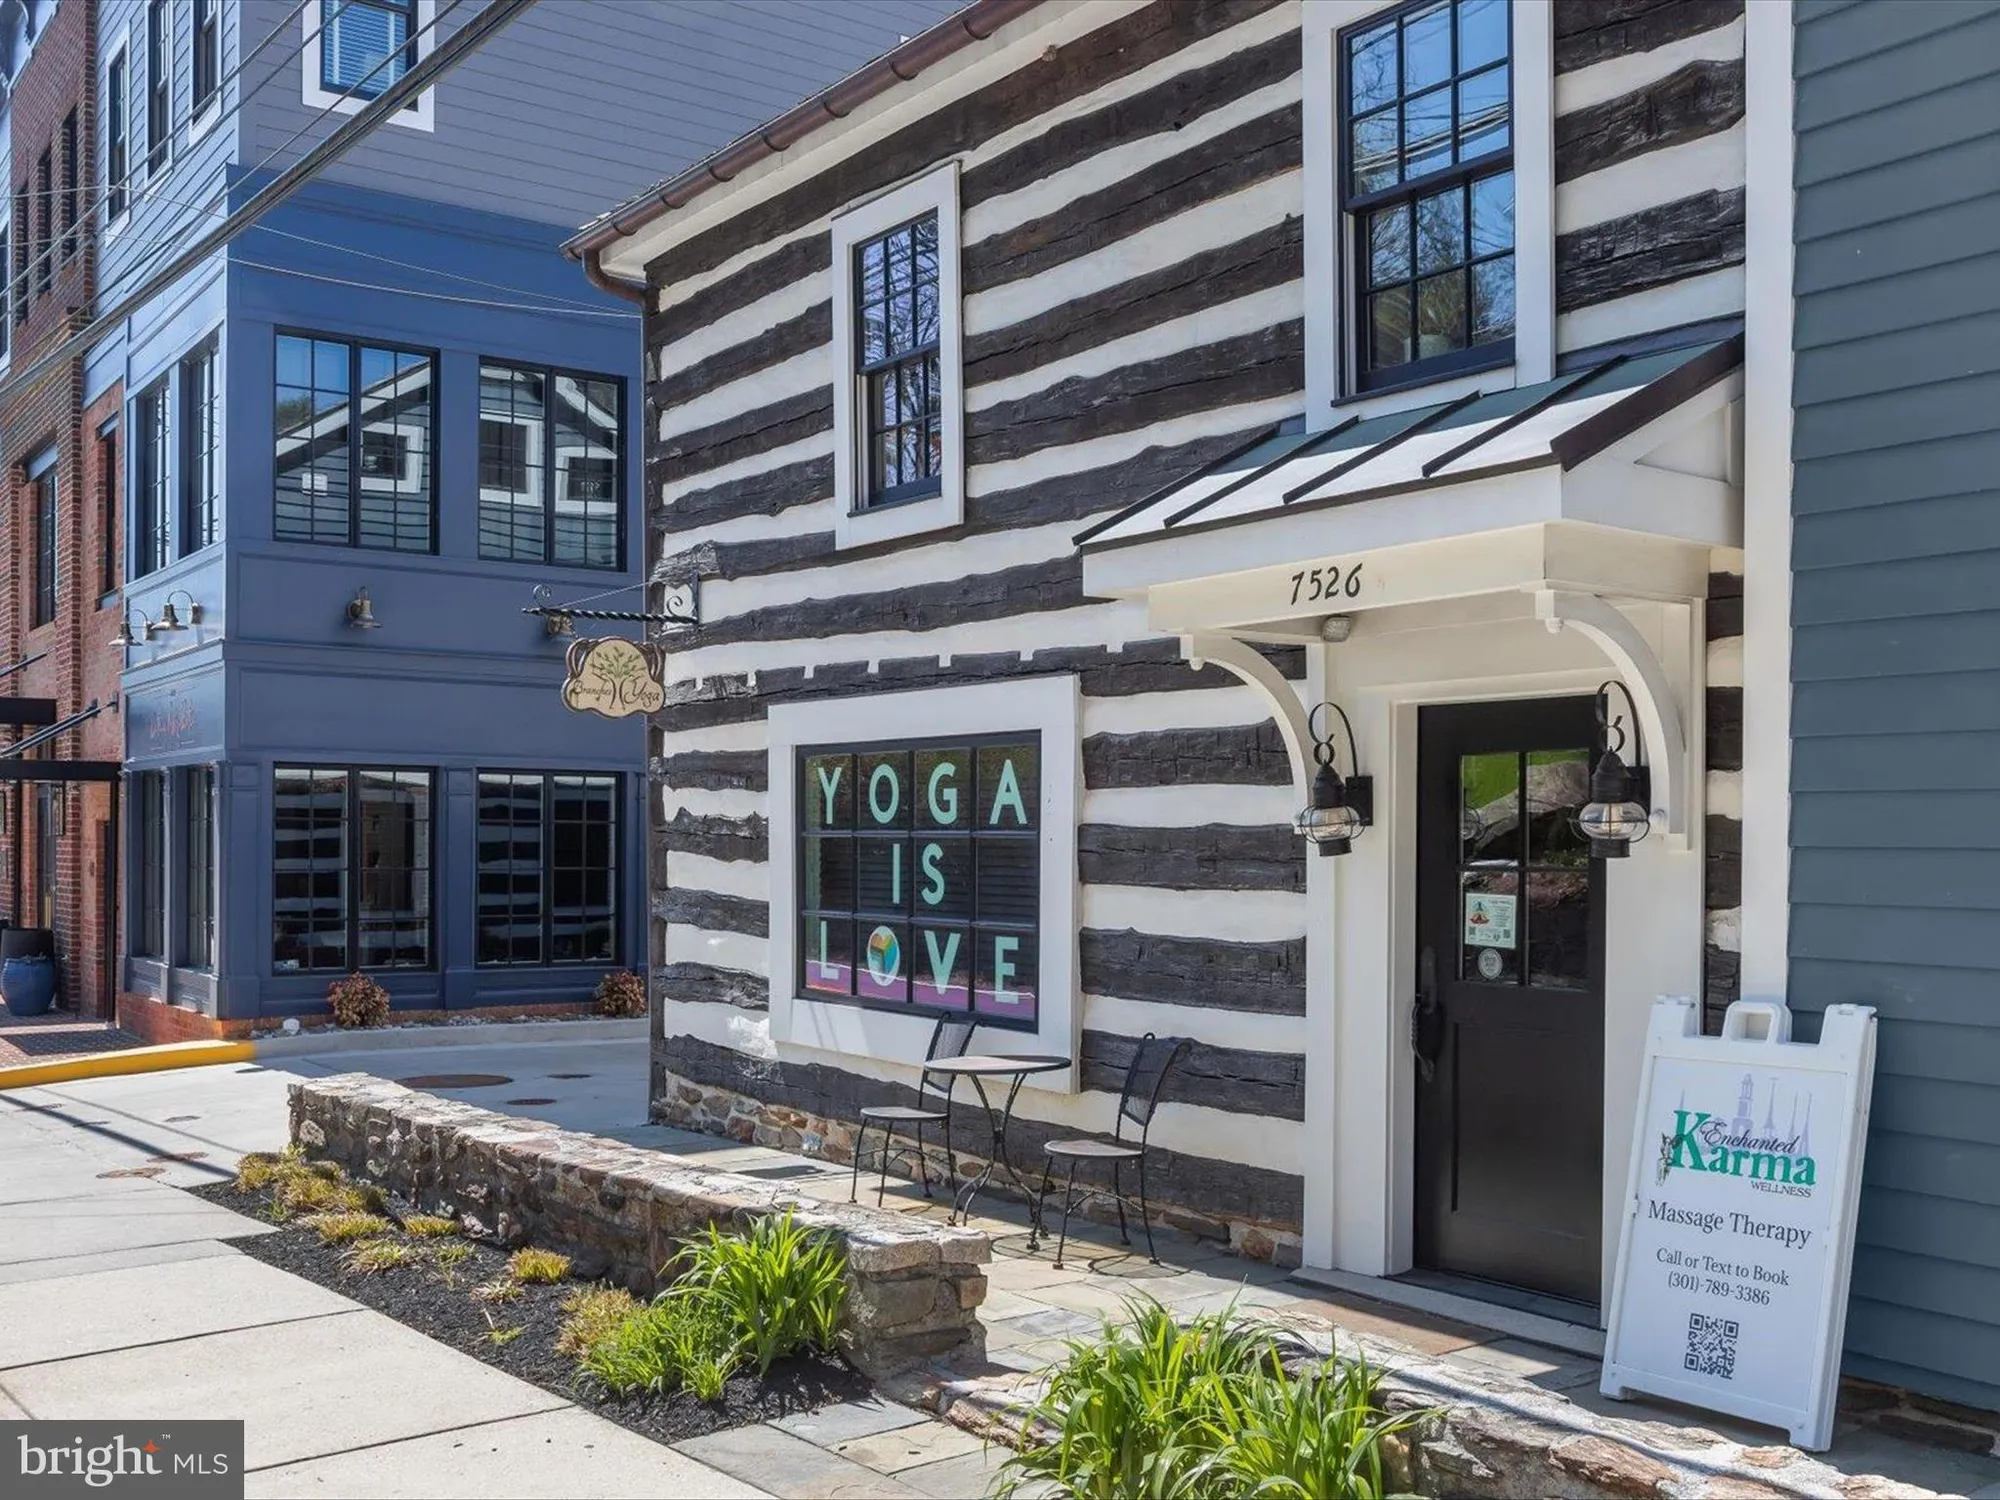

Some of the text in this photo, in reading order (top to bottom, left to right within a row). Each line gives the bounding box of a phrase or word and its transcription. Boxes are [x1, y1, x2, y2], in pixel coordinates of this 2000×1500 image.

[1291, 563, 1363, 605] 7526
[624, 677, 660, 708] Yoga
[817, 759, 1027, 824] YOGA
[892, 843, 945, 905] IS
[820, 921, 1019, 1004] LOVE
[1671, 1109, 1816, 1185] Karma
[1700, 1120, 1799, 1154] Enchanted
[1751, 1181, 1812, 1198] WELLNESS
[1648, 1200, 1812, 1249] Massage Therapy
[1656, 1247, 1789, 1286] Call or Text to Book
[1668, 1270, 1771, 1306] (301)-789-3386
